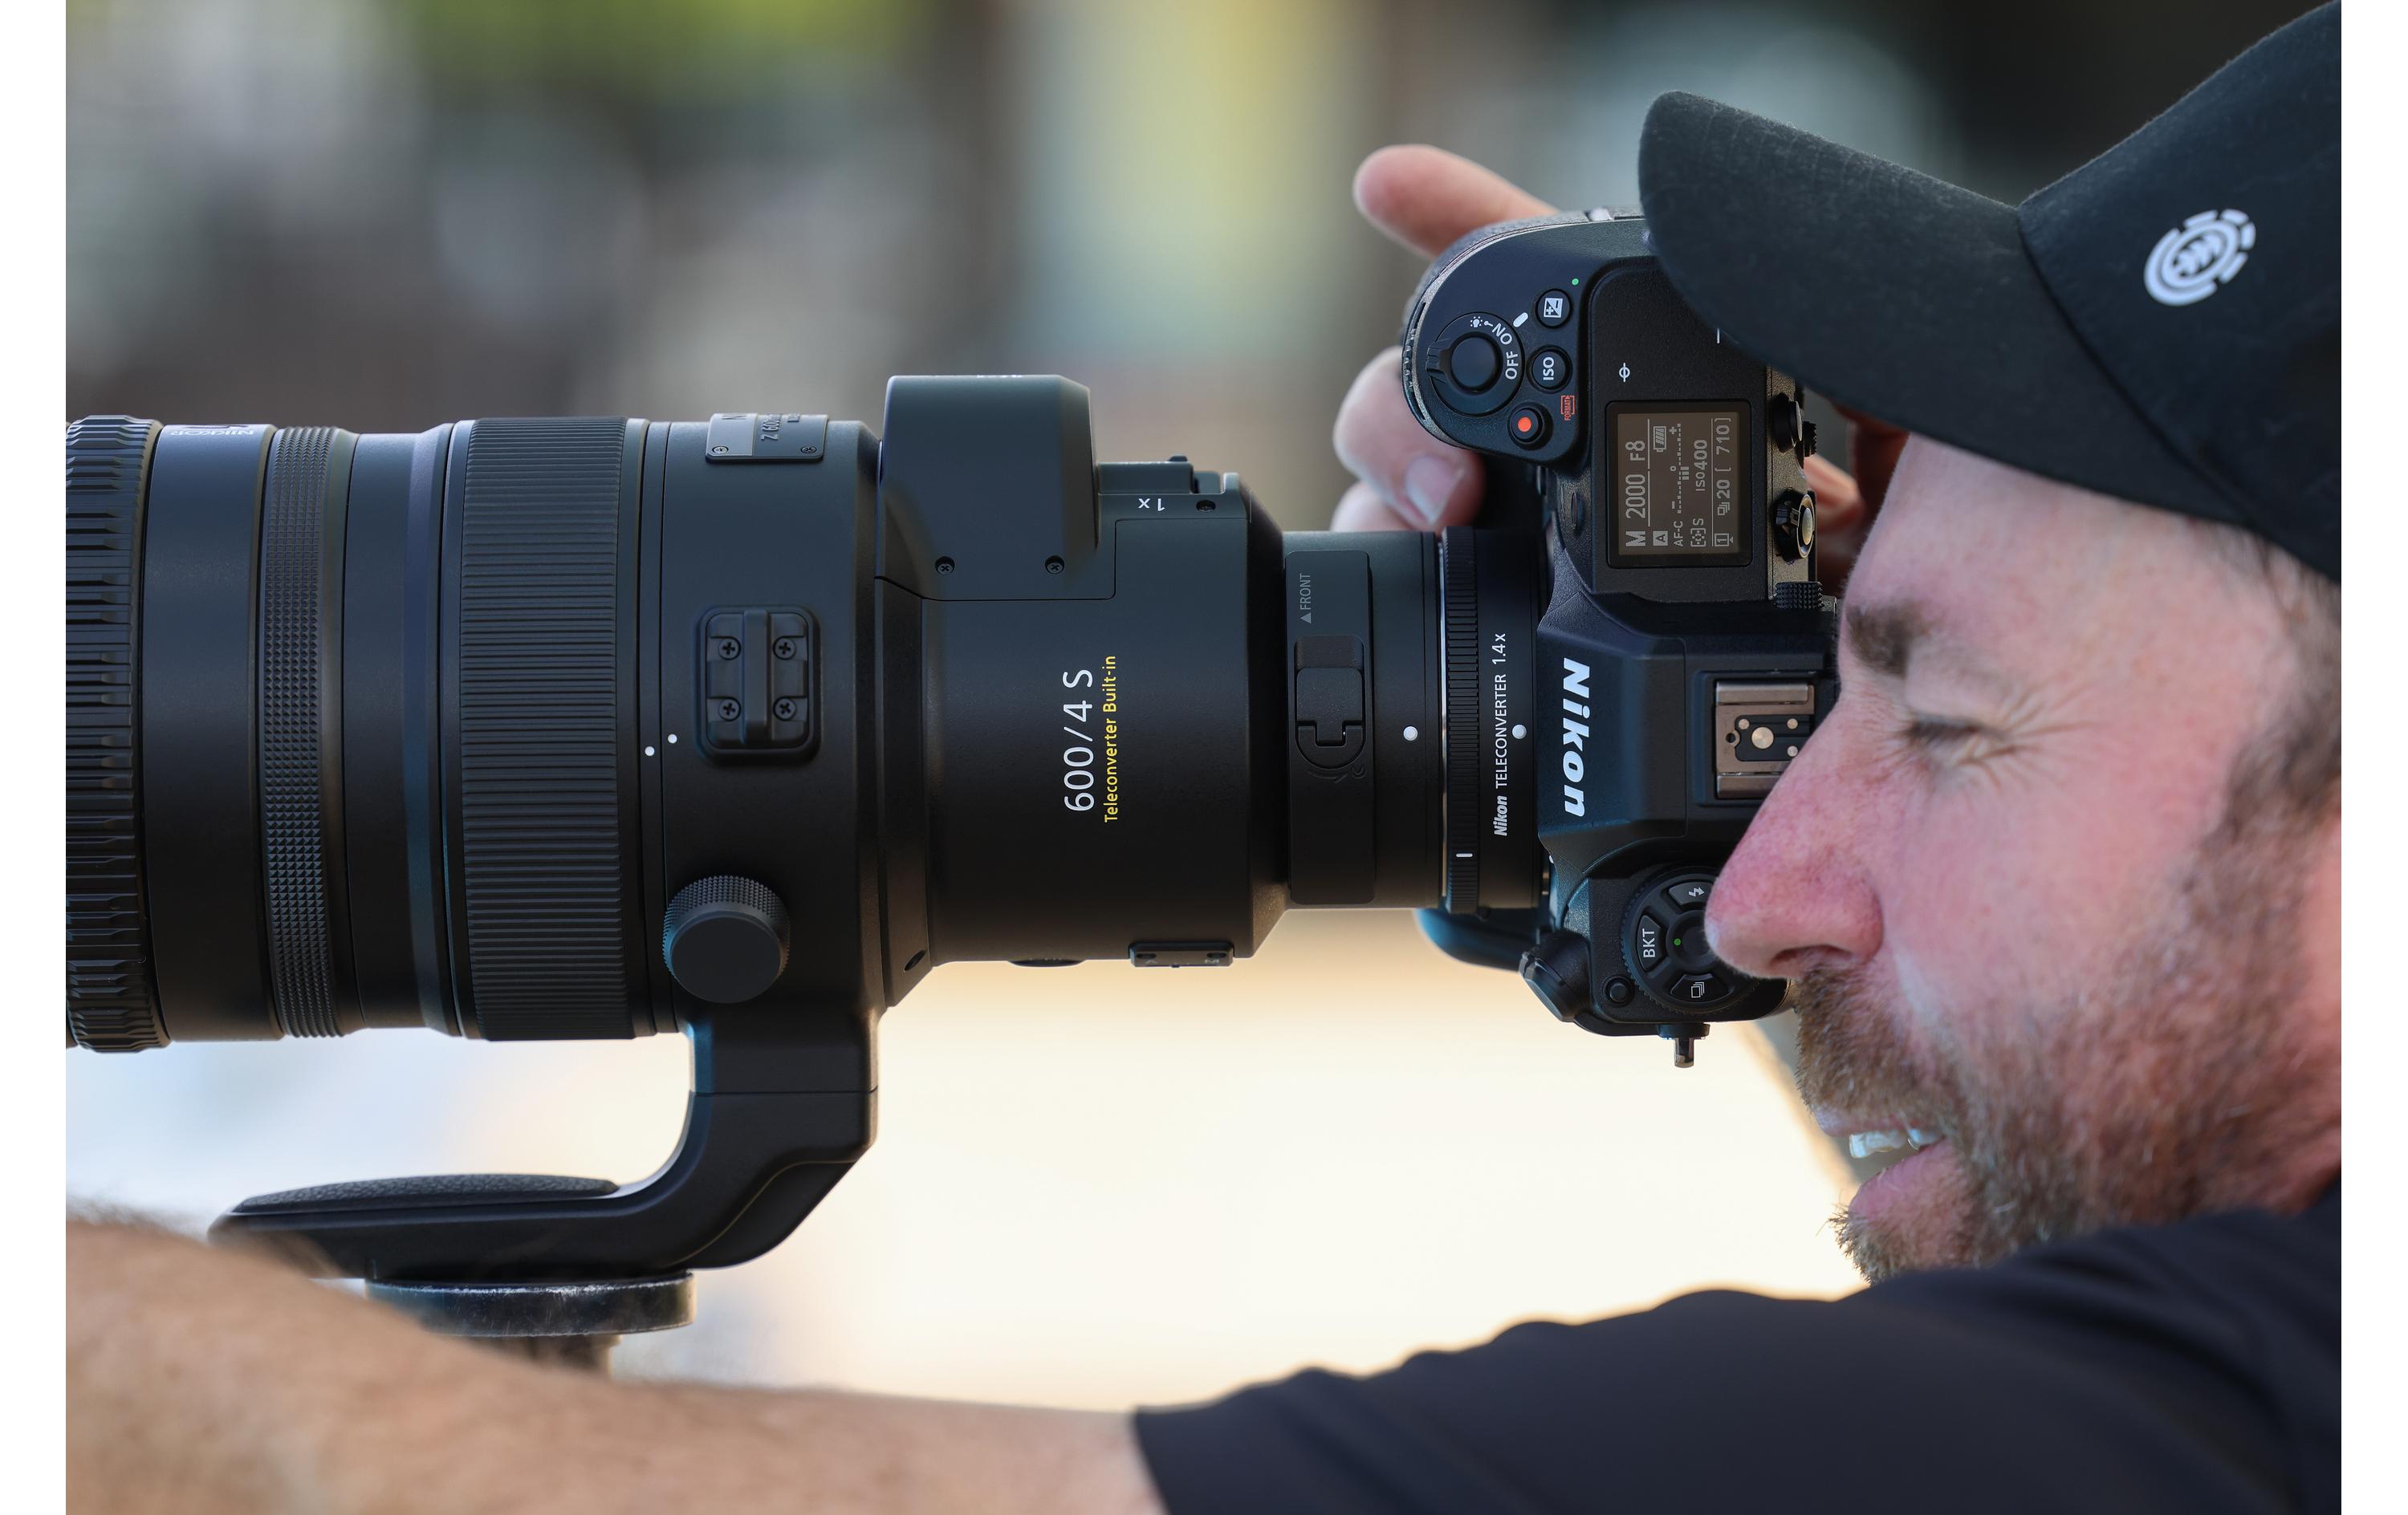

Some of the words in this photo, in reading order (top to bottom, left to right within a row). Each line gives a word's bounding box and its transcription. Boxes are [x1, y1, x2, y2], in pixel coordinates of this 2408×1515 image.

[1491, 323, 1513, 345] ON
[1505, 351, 1519, 380] OFF
[1543, 356, 1555, 380] ISO
[1625, 441, 1645, 461] F8
[1625, 473, 1646, 518] 2000
[1716, 479, 1731, 499] 20
[1674, 520, 1683, 546] AF-C
[1692, 518, 1704, 526] S
[1625, 530, 1646, 546] M
[1300, 572, 1312, 611] FRONT
[1491, 633, 1507, 665] 1.4x
[1062, 669, 1093, 688] S
[1101, 656, 1117, 713] Built-in
[1495, 673, 1507, 789] TELECONVERTER
[1562, 657, 1591, 818] Nikon
[1063, 700, 1095, 811] 600/4
[1103, 717, 1118, 822] Teleconverter
[1494, 795, 1507, 836] Nikon
[1641, 928, 1656, 958] BKT
